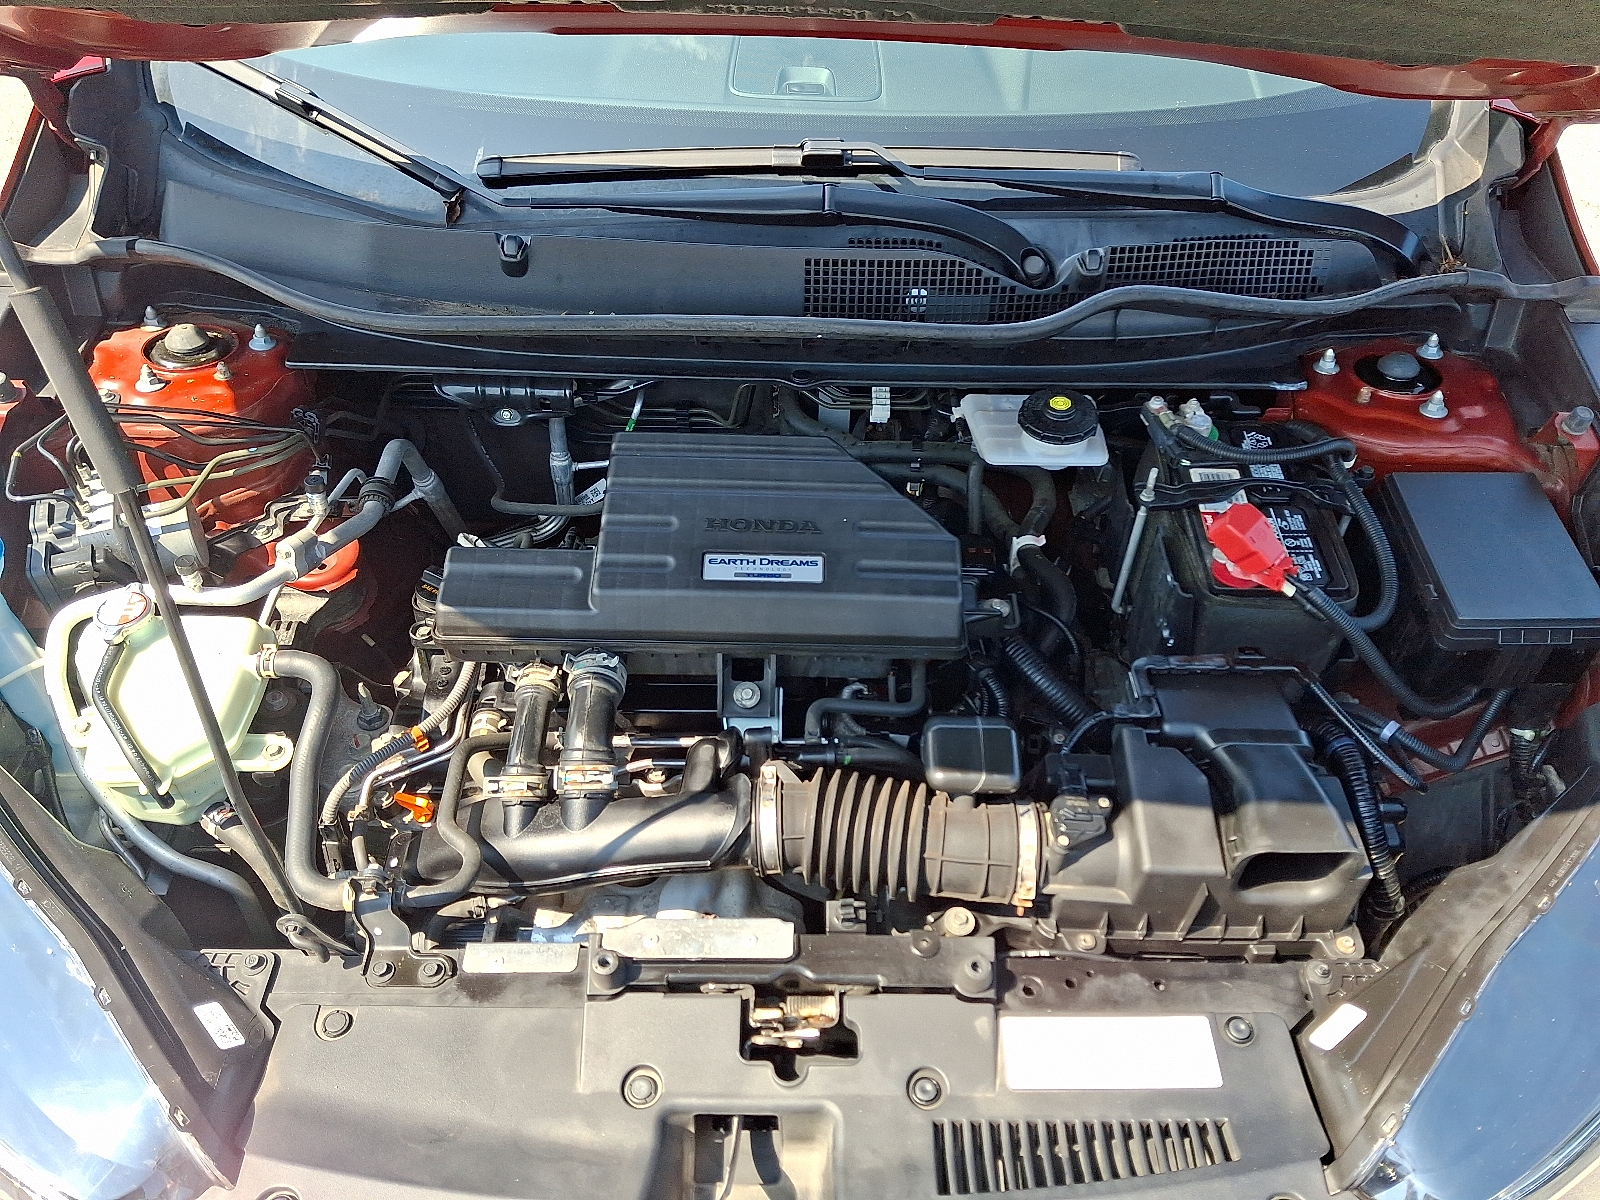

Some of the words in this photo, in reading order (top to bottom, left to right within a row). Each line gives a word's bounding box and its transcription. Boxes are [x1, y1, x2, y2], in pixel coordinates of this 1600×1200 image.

[705, 517, 823, 533] HONDA
[708, 558, 757, 566] EARTH
[759, 557, 819, 567] DREAMS
